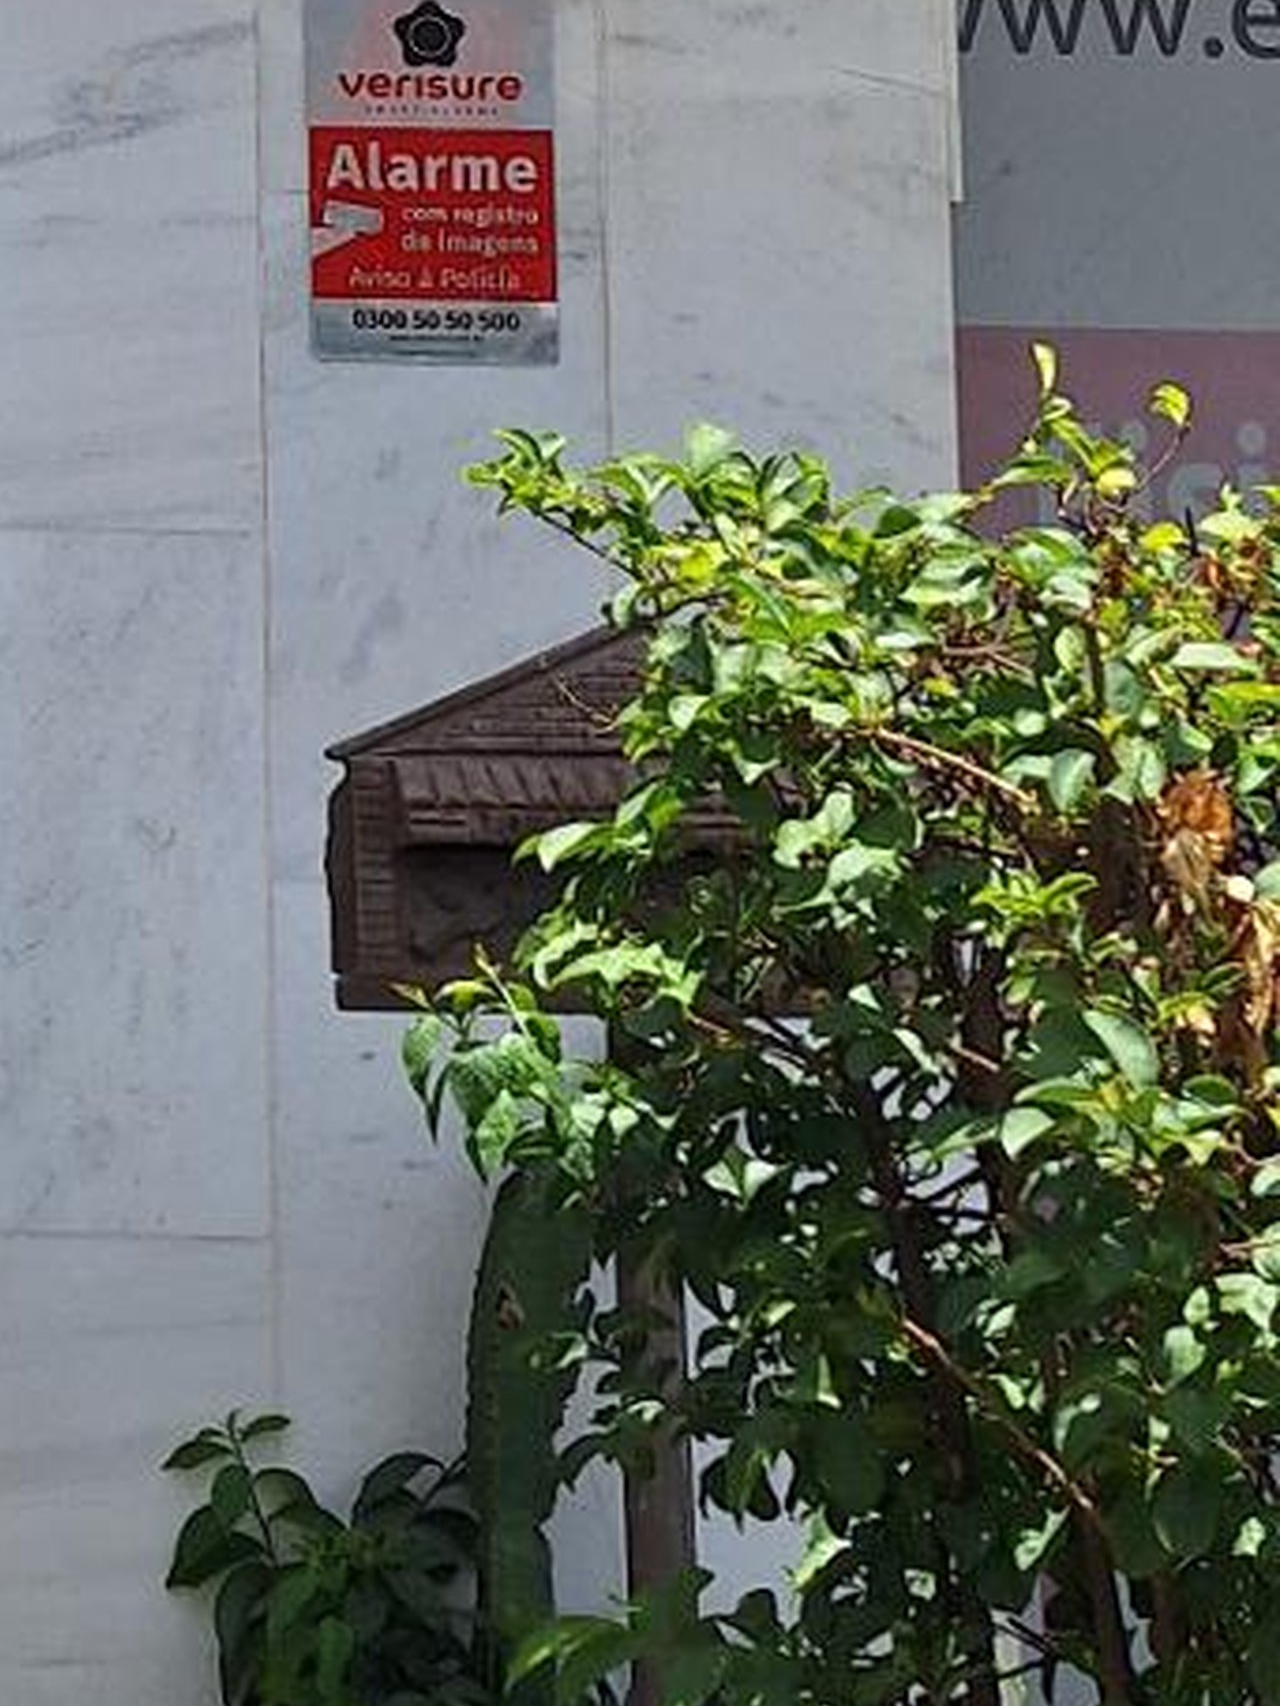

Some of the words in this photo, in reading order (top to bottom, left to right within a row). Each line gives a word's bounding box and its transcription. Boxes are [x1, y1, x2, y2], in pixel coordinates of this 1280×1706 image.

[338, 72, 523, 101] verisure
[326, 140, 538, 193] Alarme
[352, 308, 408, 331] 0300
[411, 309, 440, 331] 50
[443, 310, 473, 332] 50
[477, 310, 521, 333] 500
